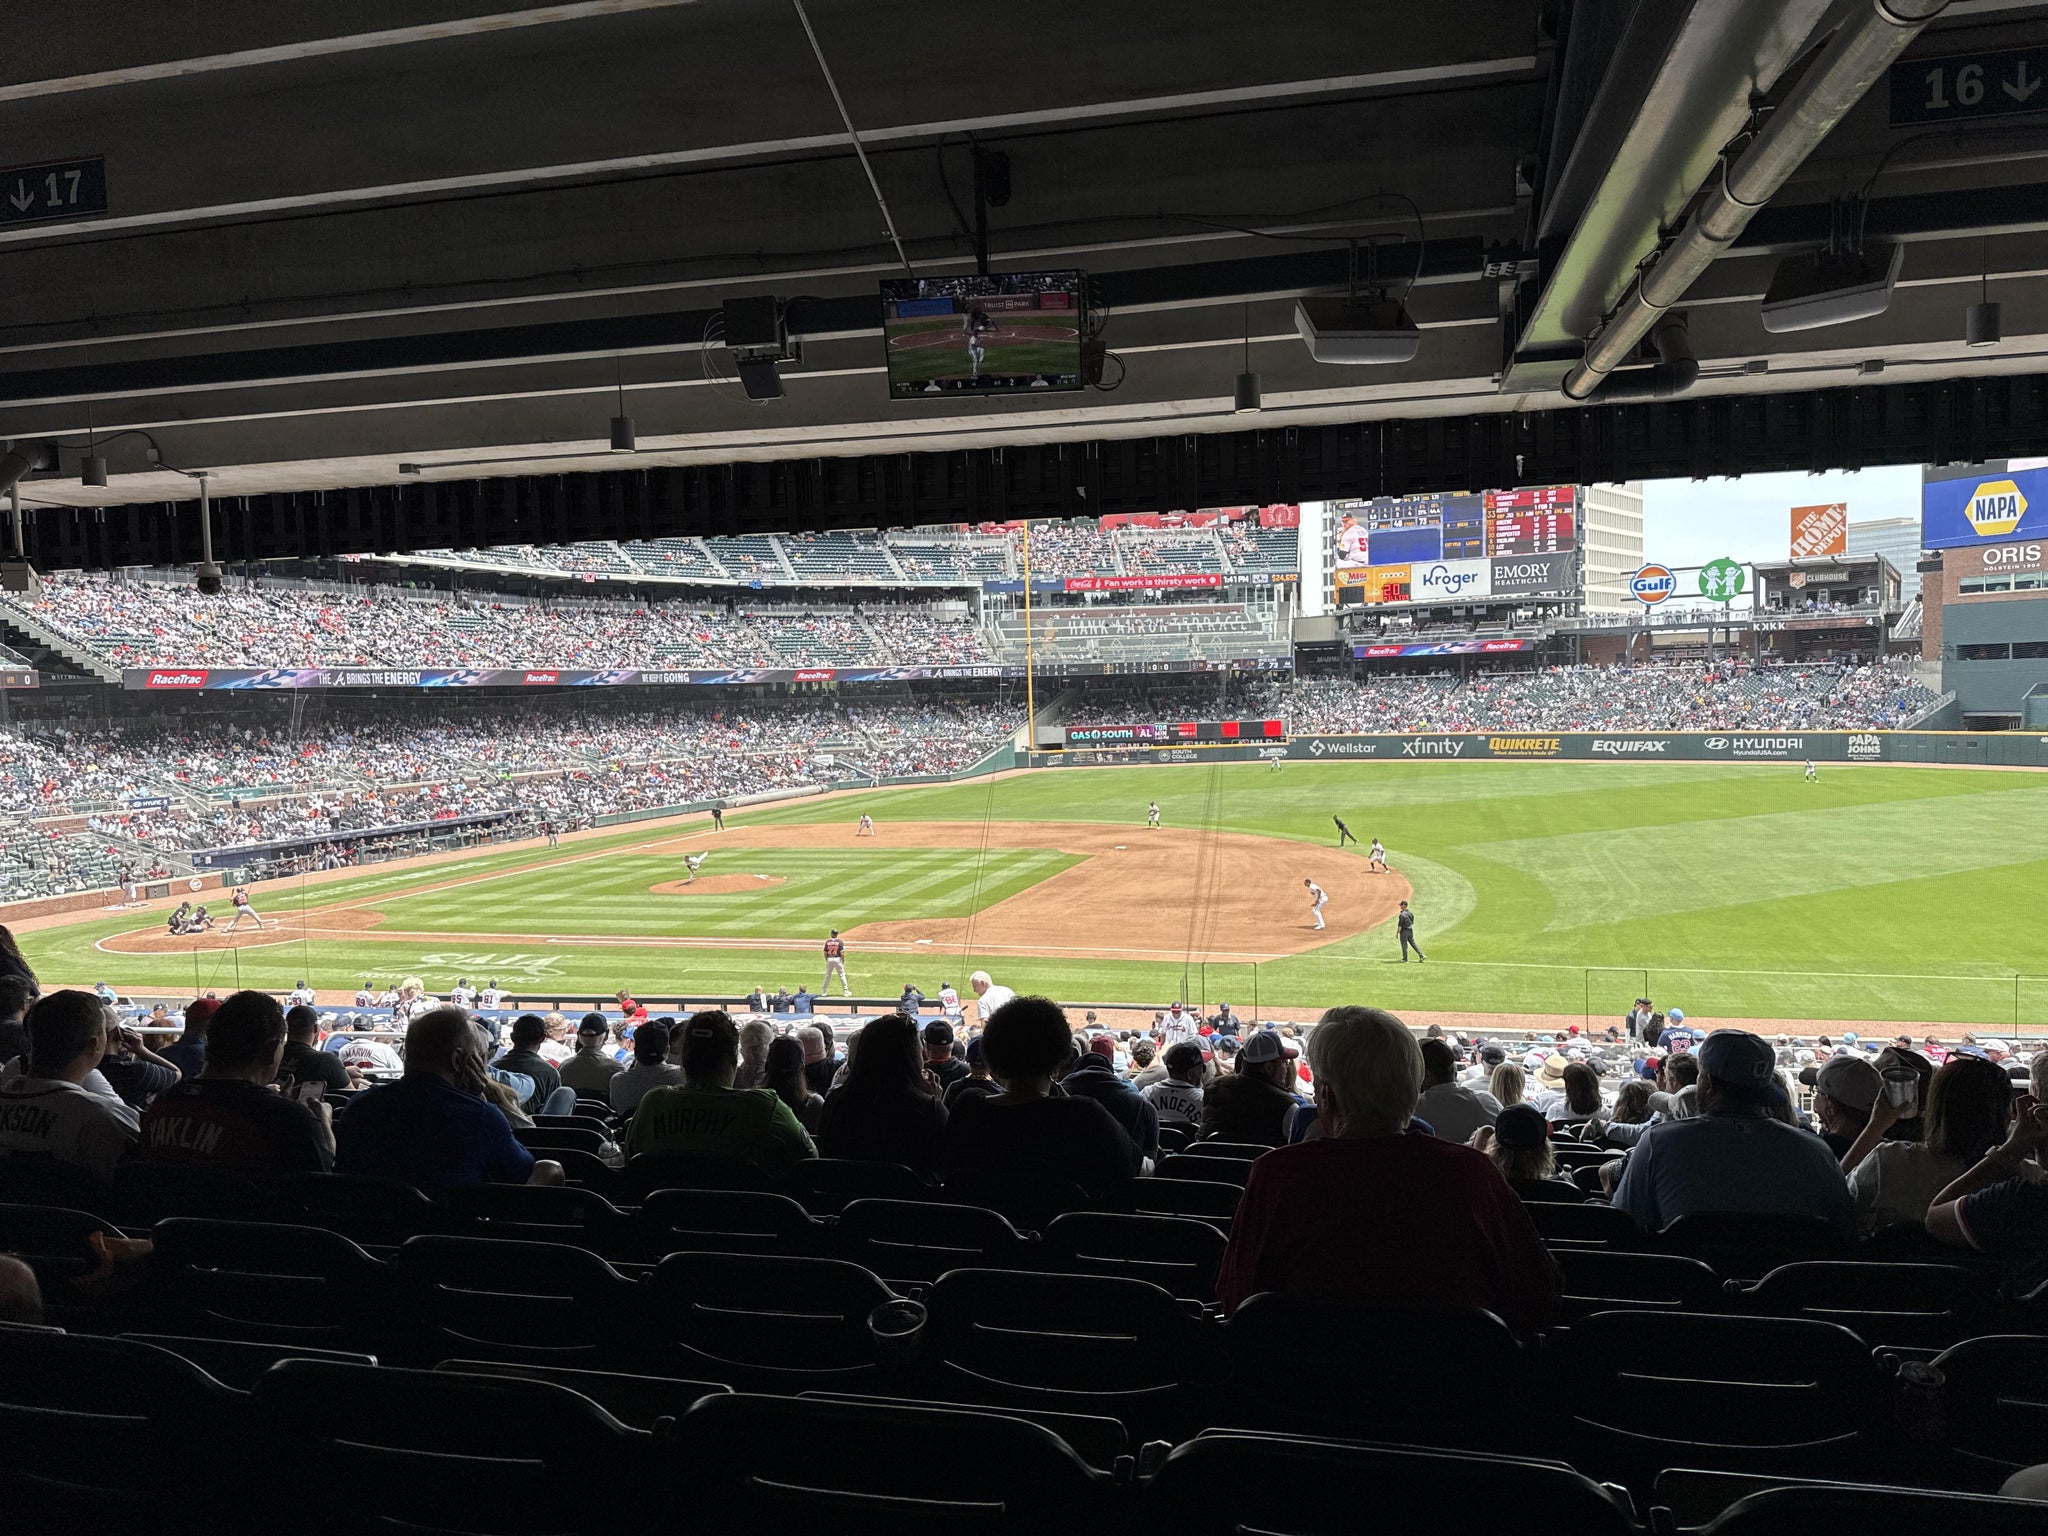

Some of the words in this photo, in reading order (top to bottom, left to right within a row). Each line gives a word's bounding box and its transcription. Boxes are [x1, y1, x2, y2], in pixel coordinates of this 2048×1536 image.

[1925, 63, 1985, 109] 16
[45, 169, 81, 207] 17
[1487, 510, 1496, 518] 33
[1975, 494, 2018, 522] NAPA
[1796, 511, 1819, 532] THE
[1791, 504, 1846, 557] HOME
[1812, 521, 1846, 556] DEPOT
[1982, 544, 2042, 566] ORIS
[1348, 572, 1367, 580] MEGA
[1494, 563, 1550, 580] EMORY
[1806, 572, 1848, 582] CLUBHOUSE
[1069, 580, 1092, 589] Coca-Cola
[1104, 579, 1119, 587] Fan
[1120, 579, 1143, 587] work
[1153, 577, 1184, 587] thirsty
[1186, 577, 1207, 585] work
[1423, 565, 1478, 594] Kroger
[1495, 576, 1548, 586] HEALTHCARE
[1633, 578, 1672, 592] Gulf
[1383, 584, 1400, 596] 20
[1069, 619, 1109, 635] HANK
[1116, 618, 1168, 634] AARON
[1173, 615, 1247, 632] TERRACE
[1865, 617, 1874, 626] 4
[1367, 647, 1398, 656] RaceTrac
[1486, 642, 1519, 650] RaceTrac
[526, 674, 556, 682] RaceTrac
[641, 673, 649, 682] WE
[663, 672, 690, 683] GOING
[797, 671, 831, 680] RaceTrac
[922, 669, 931, 677] THE
[943, 668, 962, 677] BRINGS
[962, 668, 972, 676] THE
[972, 667, 1003, 677] ENERGY
[25, 675, 30, 684] 0
[152, 674, 202, 685] RaceTrac
[318, 673, 331, 684] THE
[346, 673, 370, 684] BRINGS
[371, 673, 383, 684] THE
[384, 672, 421, 685] ENERGY
[1071, 731, 1091, 740] GAS
[1102, 729, 1133, 738] SOUTH
[1140, 729, 1153, 738] AL
[1848, 733, 1880, 745] PAPA
[1327, 743, 1376, 753] Wellstar
[1402, 736, 1464, 757] xfinity
[1488, 737, 1561, 750] QUIKRETE
[1592, 740, 1666, 755] EQUIFAX
[1733, 738, 1803, 749] HYUNDAI
[1847, 745, 1881, 754] JOHNS
[345, 1047, 373, 1058] MARVIN
[654, 1108, 737, 1138] MURPHY
